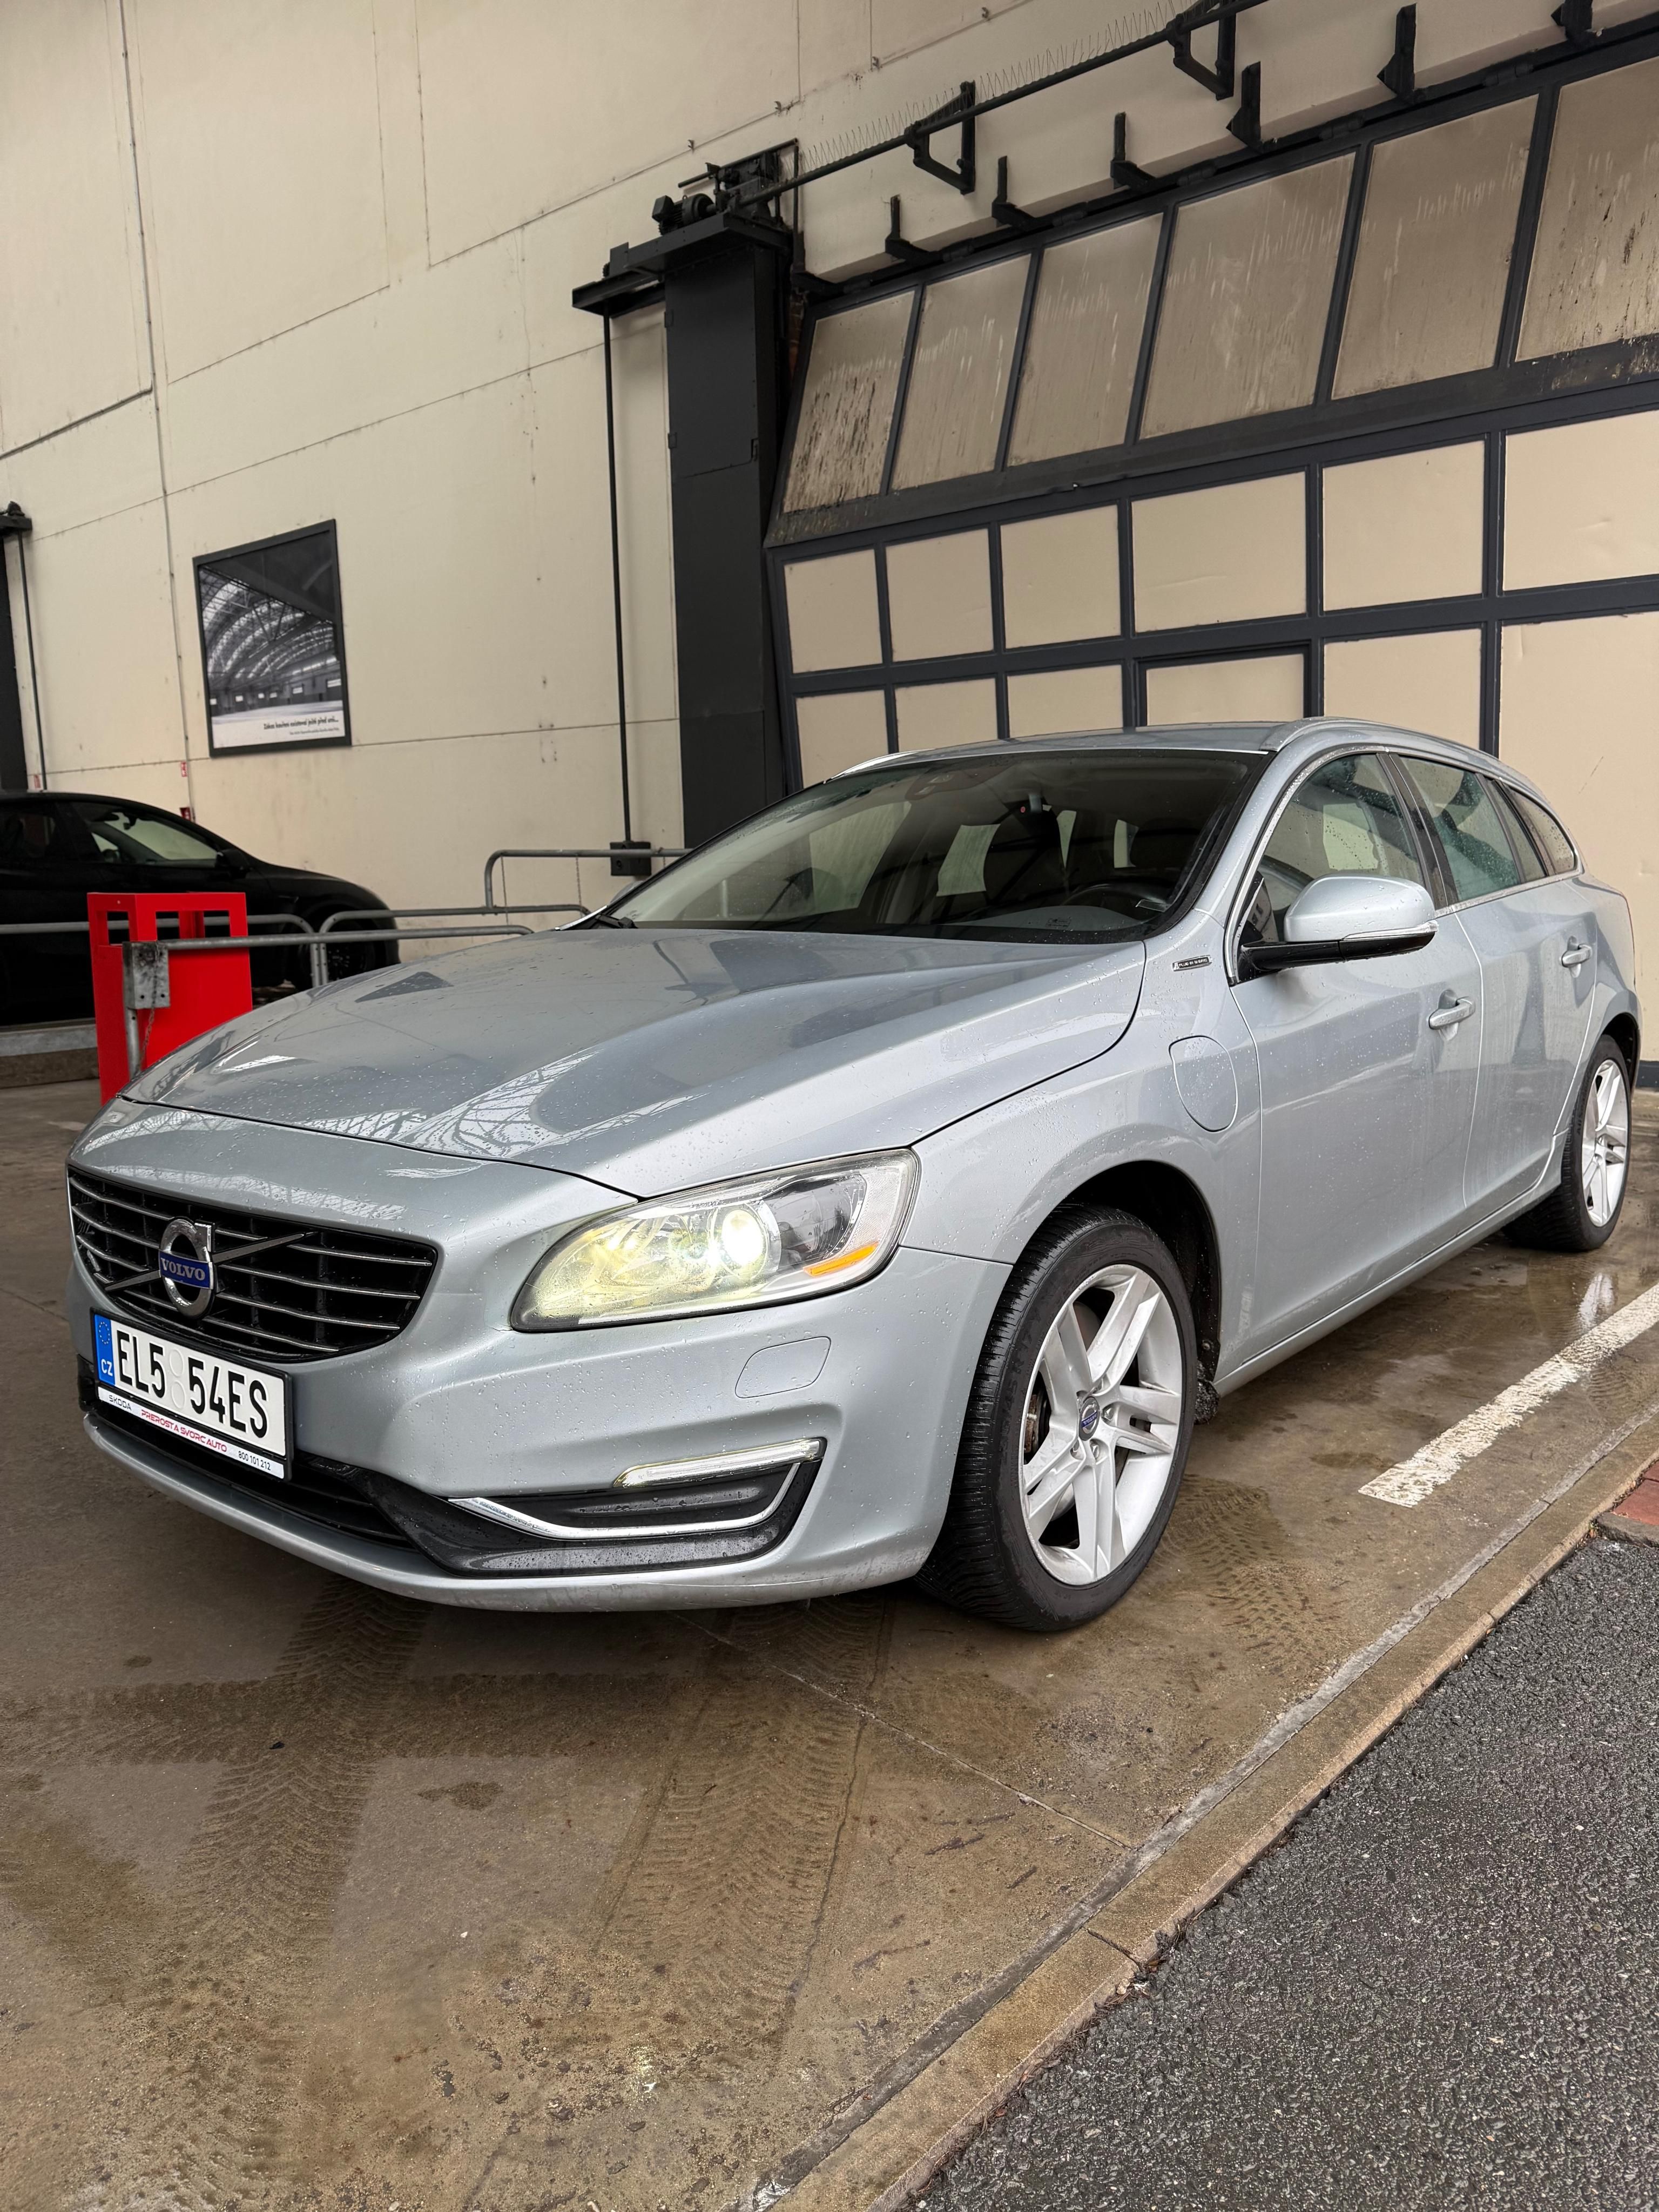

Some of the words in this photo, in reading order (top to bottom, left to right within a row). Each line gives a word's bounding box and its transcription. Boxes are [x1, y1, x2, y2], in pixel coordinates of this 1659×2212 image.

[160, 1257, 206, 1281] VOLVO
[101, 1358, 113, 1377] CZ
[117, 1330, 165, 1398] EL5
[188, 1357, 268, 1438] 54ES
[206, 1439, 227, 1452] AUTO
[238, 1451, 248, 1461] 800
[250, 1455, 259, 1466] 101
[260, 1460, 271, 1471] 212
